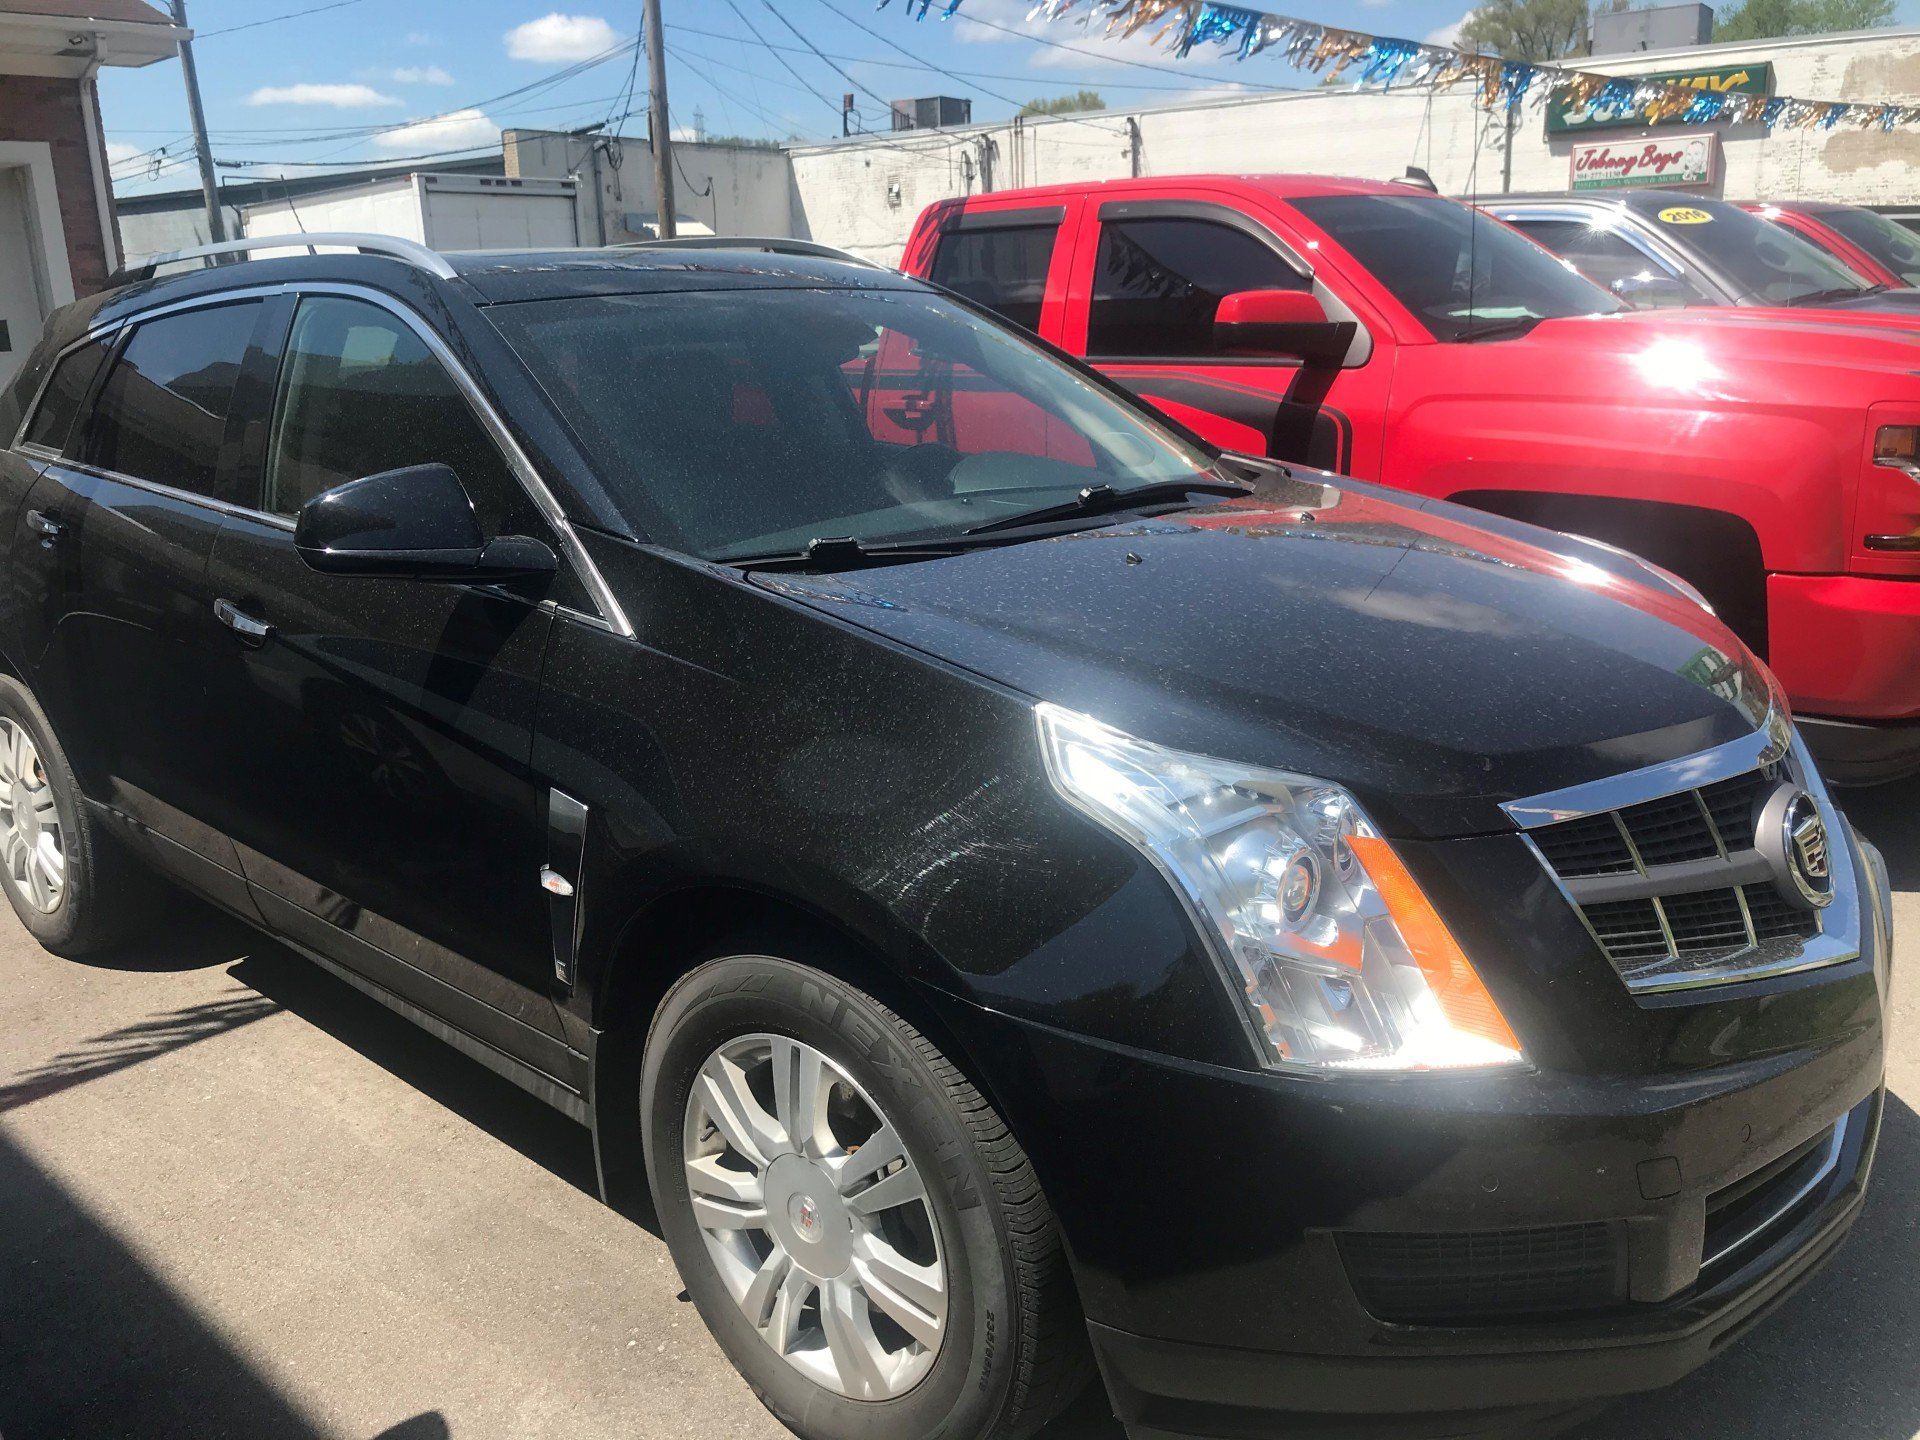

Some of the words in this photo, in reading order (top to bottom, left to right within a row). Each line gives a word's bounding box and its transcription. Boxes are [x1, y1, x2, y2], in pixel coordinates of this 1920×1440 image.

[1575, 148, 1638, 175] Johnny
[1638, 144, 1684, 174] Boys
[1666, 210, 1707, 222] 2016
